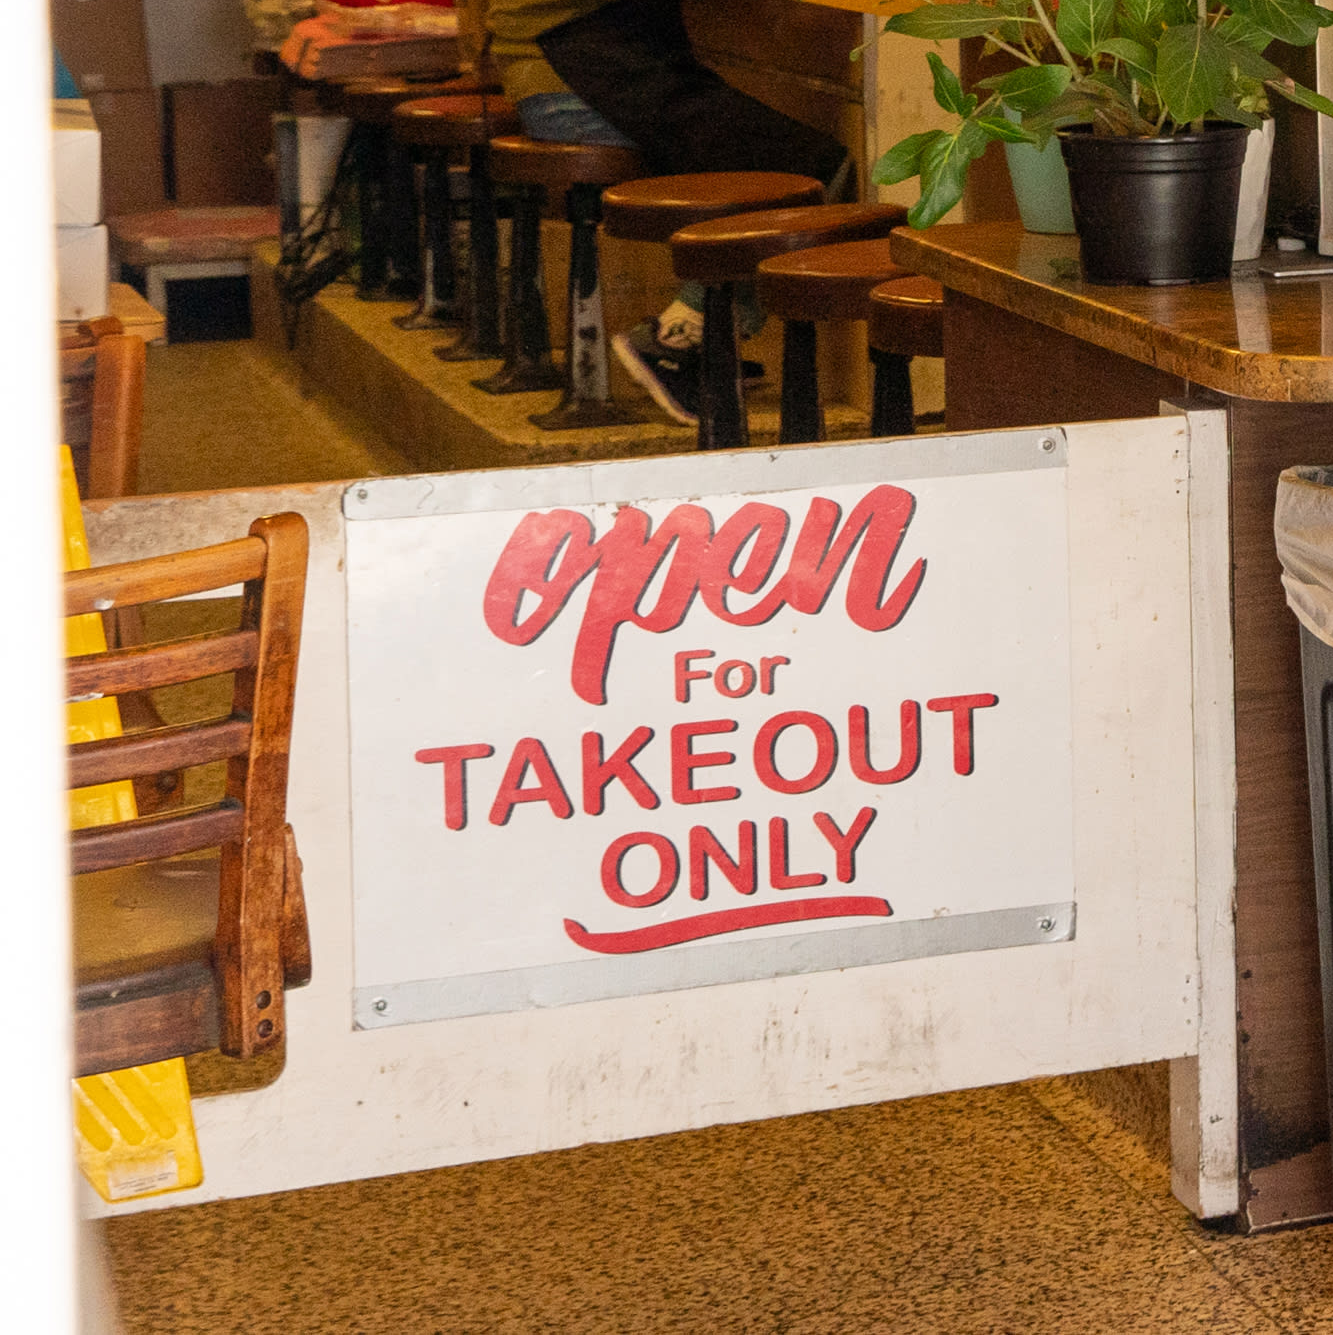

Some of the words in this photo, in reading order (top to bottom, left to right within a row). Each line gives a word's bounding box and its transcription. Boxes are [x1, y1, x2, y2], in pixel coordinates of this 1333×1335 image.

[483, 483, 926, 705] open
[675, 649, 790, 703] For
[414, 691, 1000, 832] TAKEOUT
[600, 806, 878, 910] ONLY
